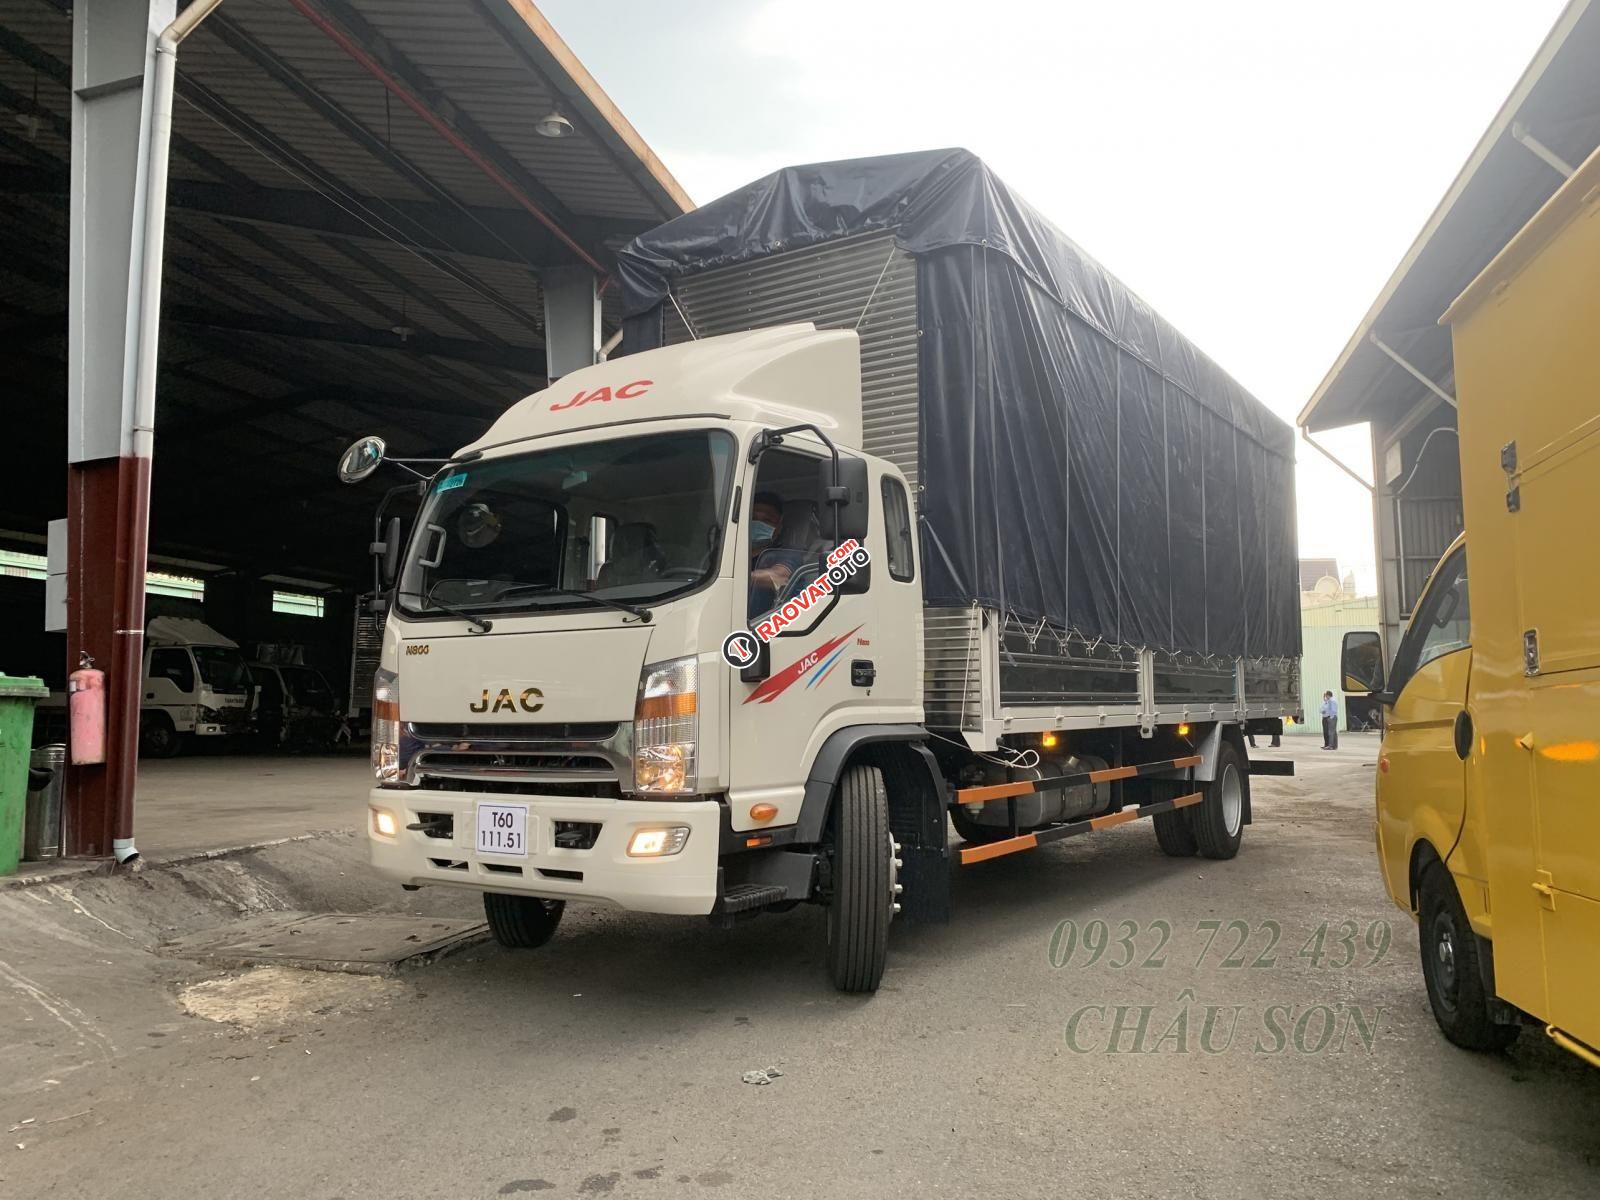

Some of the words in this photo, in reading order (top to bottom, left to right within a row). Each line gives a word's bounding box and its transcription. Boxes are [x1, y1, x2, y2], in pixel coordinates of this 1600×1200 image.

[550, 379, 654, 411] JAC
[797, 652, 819, 675] JAC
[469, 687, 544, 713] JAC
[491, 811, 514, 829] T60
[481, 830, 521, 849] 111.51
